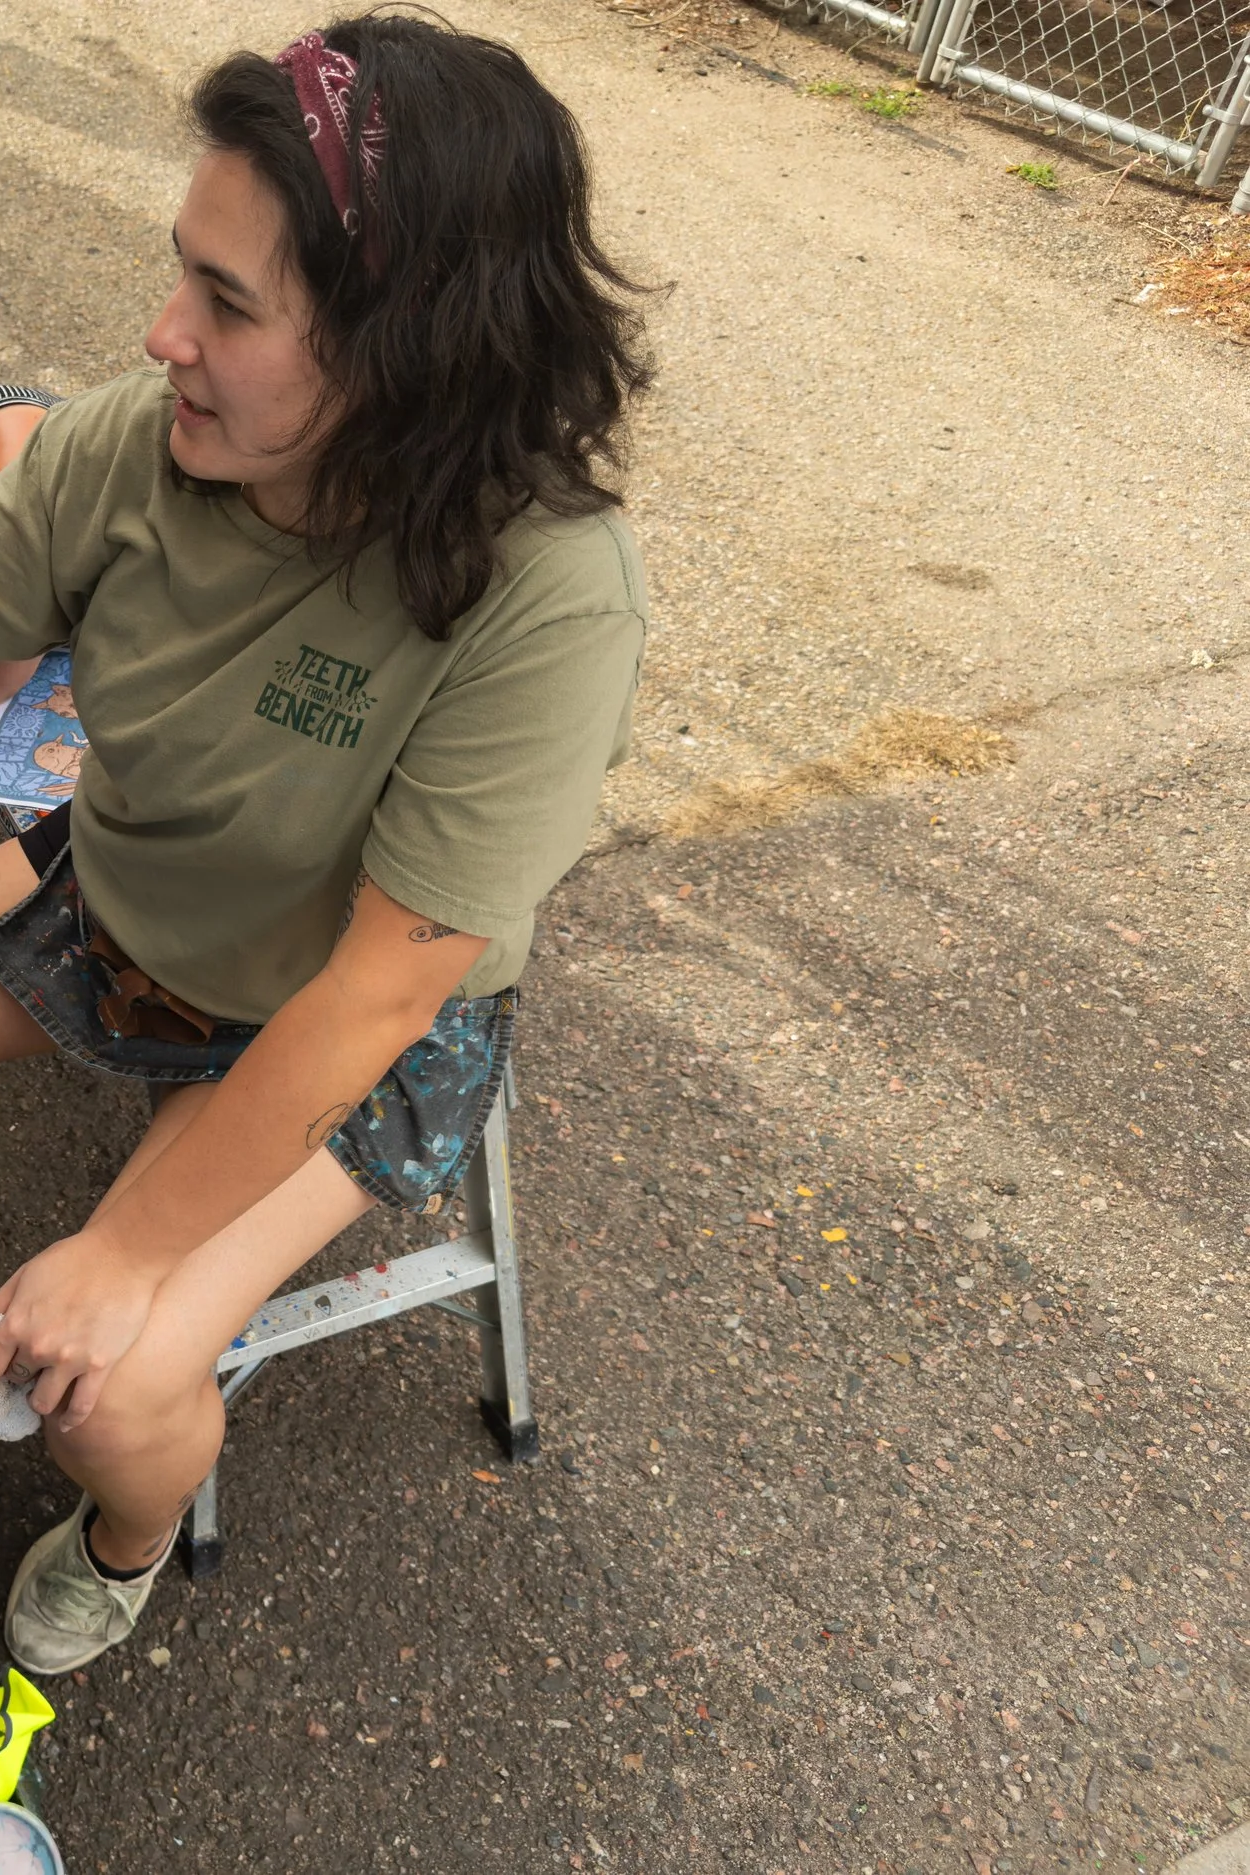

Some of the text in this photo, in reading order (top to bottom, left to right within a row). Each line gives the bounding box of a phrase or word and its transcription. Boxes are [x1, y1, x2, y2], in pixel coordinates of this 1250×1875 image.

[292, 644, 372, 697] TEETH
[304, 683, 334, 704] FROM
[253, 681, 365, 749] BENEATH
